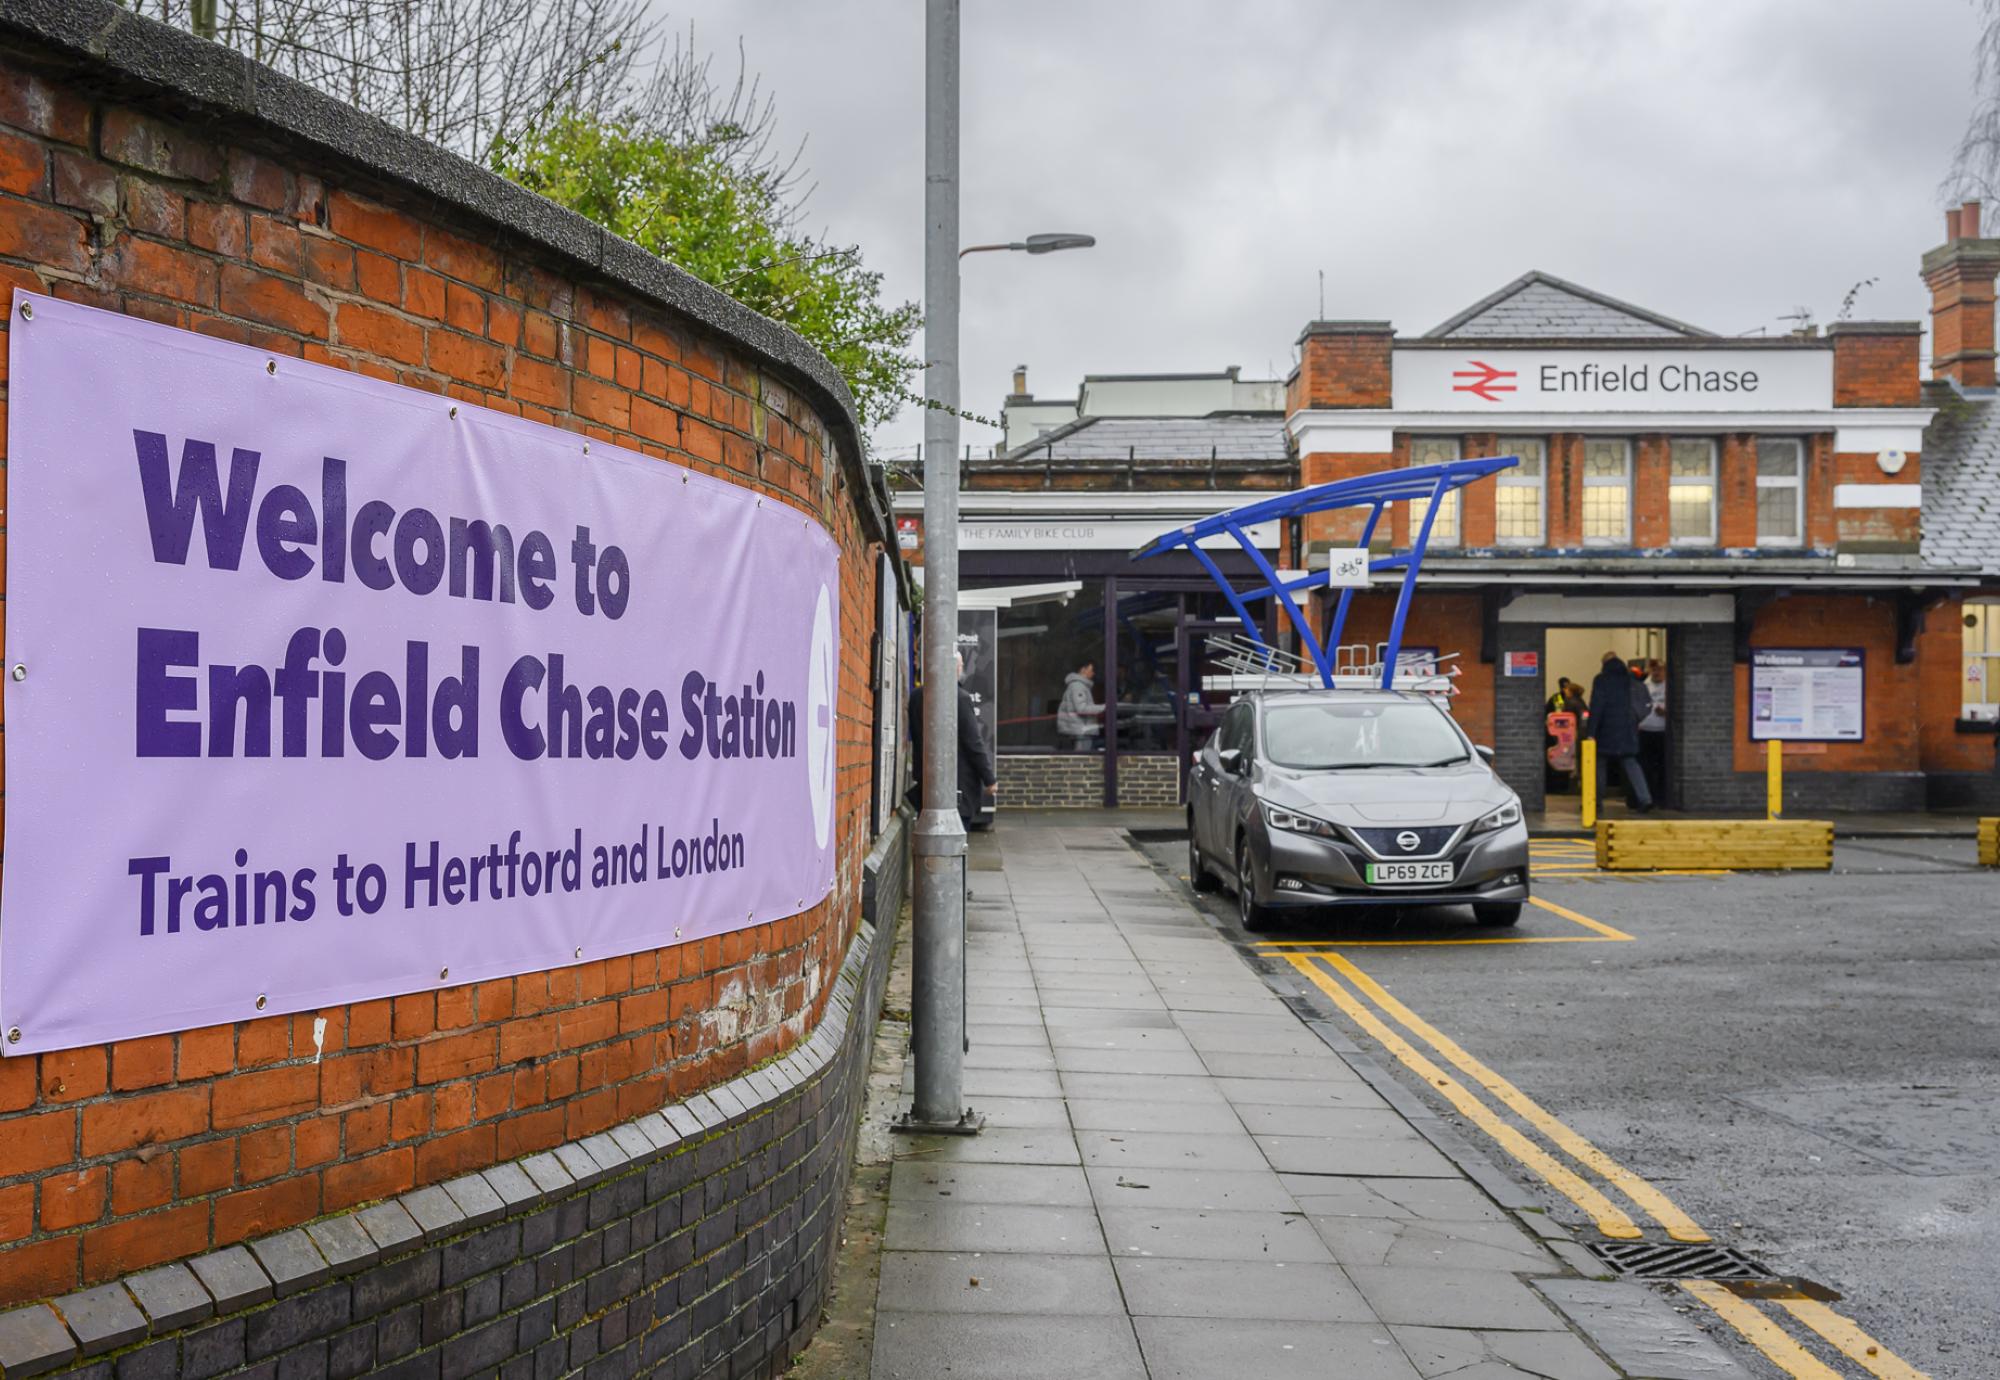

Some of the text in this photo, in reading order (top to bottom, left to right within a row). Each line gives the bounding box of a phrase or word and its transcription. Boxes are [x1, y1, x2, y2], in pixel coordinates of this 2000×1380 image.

[1540, 363, 1759, 393] Enfield Chase
[133, 428, 630, 620] Welcome to
[963, 528, 1095, 539] THE FAMILY BIKE CLUB
[1754, 655, 1804, 666] Welcome
[136, 626, 480, 760] Enfield
[500, 653, 668, 762] Chase
[679, 670, 796, 761] Station
[128, 817, 745, 937] Trains to Hertford and London
[1377, 864, 1451, 880] LP69 ZCF
